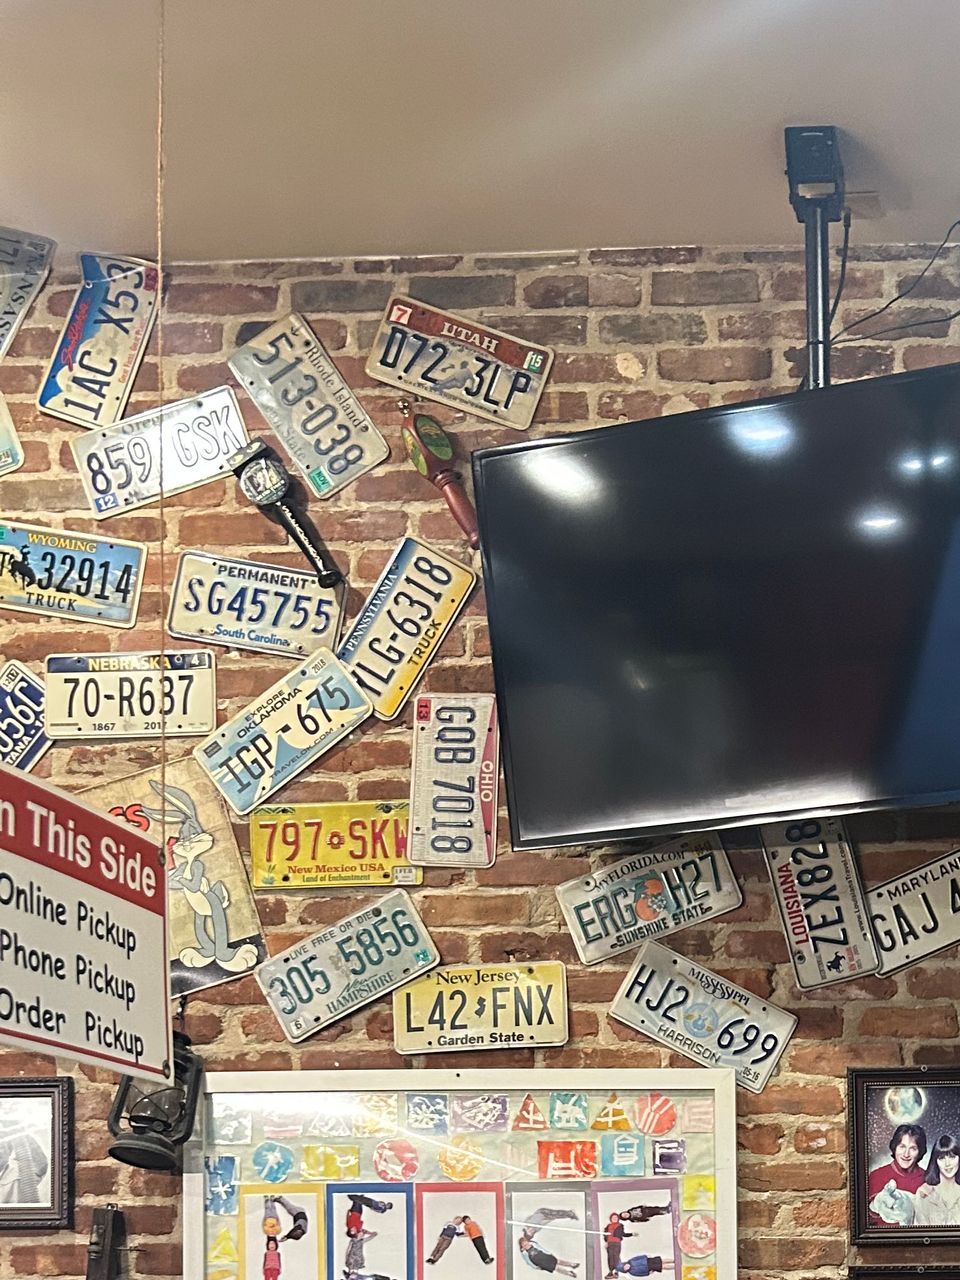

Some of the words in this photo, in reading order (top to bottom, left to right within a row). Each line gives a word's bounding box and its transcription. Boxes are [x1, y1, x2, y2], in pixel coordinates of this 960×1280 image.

[64, 350, 118, 420] 1AC
[94, 263, 144, 334] X53
[440, 321, 499, 354] UTAH
[304, 344, 336, 388] Rhode
[380, 326, 449, 384] D72
[464, 356, 532, 409] 3LP
[252, 331, 365, 476] 513-038
[87, 436, 153, 495] 859
[173, 405, 244, 468] GSK
[27, 532, 97, 554] WYOMING
[26, 591, 78, 612] TRUCK
[37, 551, 134, 604] 32914
[217, 564, 310, 590] PERMANENT
[183, 576, 334, 635] SG45755
[347, 573, 397, 652] PENNSYLVANIA
[214, 623, 246, 641] South
[247, 629, 289, 647] Carolina
[407, 618, 443, 667] TRUCK
[88, 657, 172, 671] NEBRASKA
[92, 722, 116, 732] 1867
[143, 721, 168, 731] 2017
[237, 687, 303, 739] OKLAHOMA
[245, 690, 286, 723] EXPLORE
[481, 760, 494, 802] OHIO
[430, 776, 476, 854] 7018
[27, 800, 92, 869] This
[100, 836, 157, 898] Side
[258, 820, 324, 863] 797
[287, 864, 314, 875] New
[315, 863, 358, 875] Mexico
[360, 862, 386, 873] USA
[785, 821, 849, 954] ZEX828
[0, 872, 68, 926] Online
[77, 900, 137, 960] Pickup
[573, 886, 637, 944] ERG
[661, 851, 723, 911] H27
[776, 861, 810, 946] LOUISIANA
[871, 891, 940, 953] GAJ
[289, 943, 310, 961] LIVE
[310, 929, 337, 950] FREE
[338, 920, 355, 934] OR
[356, 911, 374, 925] DIE
[615, 917, 670, 949] SUNSHINE
[0, 928, 66, 981] Phone
[76, 954, 136, 1012] Pickup
[268, 952, 332, 1016] 305
[335, 908, 421, 977] 5856
[435, 970, 473, 985] New
[474, 969, 521, 986] Jersey
[688, 967, 751, 1006] MISSISSIPPI
[325, 970, 397, 1015] HAMPSHIRE
[406, 989, 469, 1034] L42
[491, 984, 555, 1029] FNX
[625, 962, 690, 1022] HJ2
[716, 1017, 778, 1066] 699
[0, 987, 66, 1035] Order
[85, 1011, 144, 1066] Pickup
[437, 1034, 484, 1047] Garden
[489, 1032, 525, 1044] State
[656, 1024, 721, 1064] HARRISON
